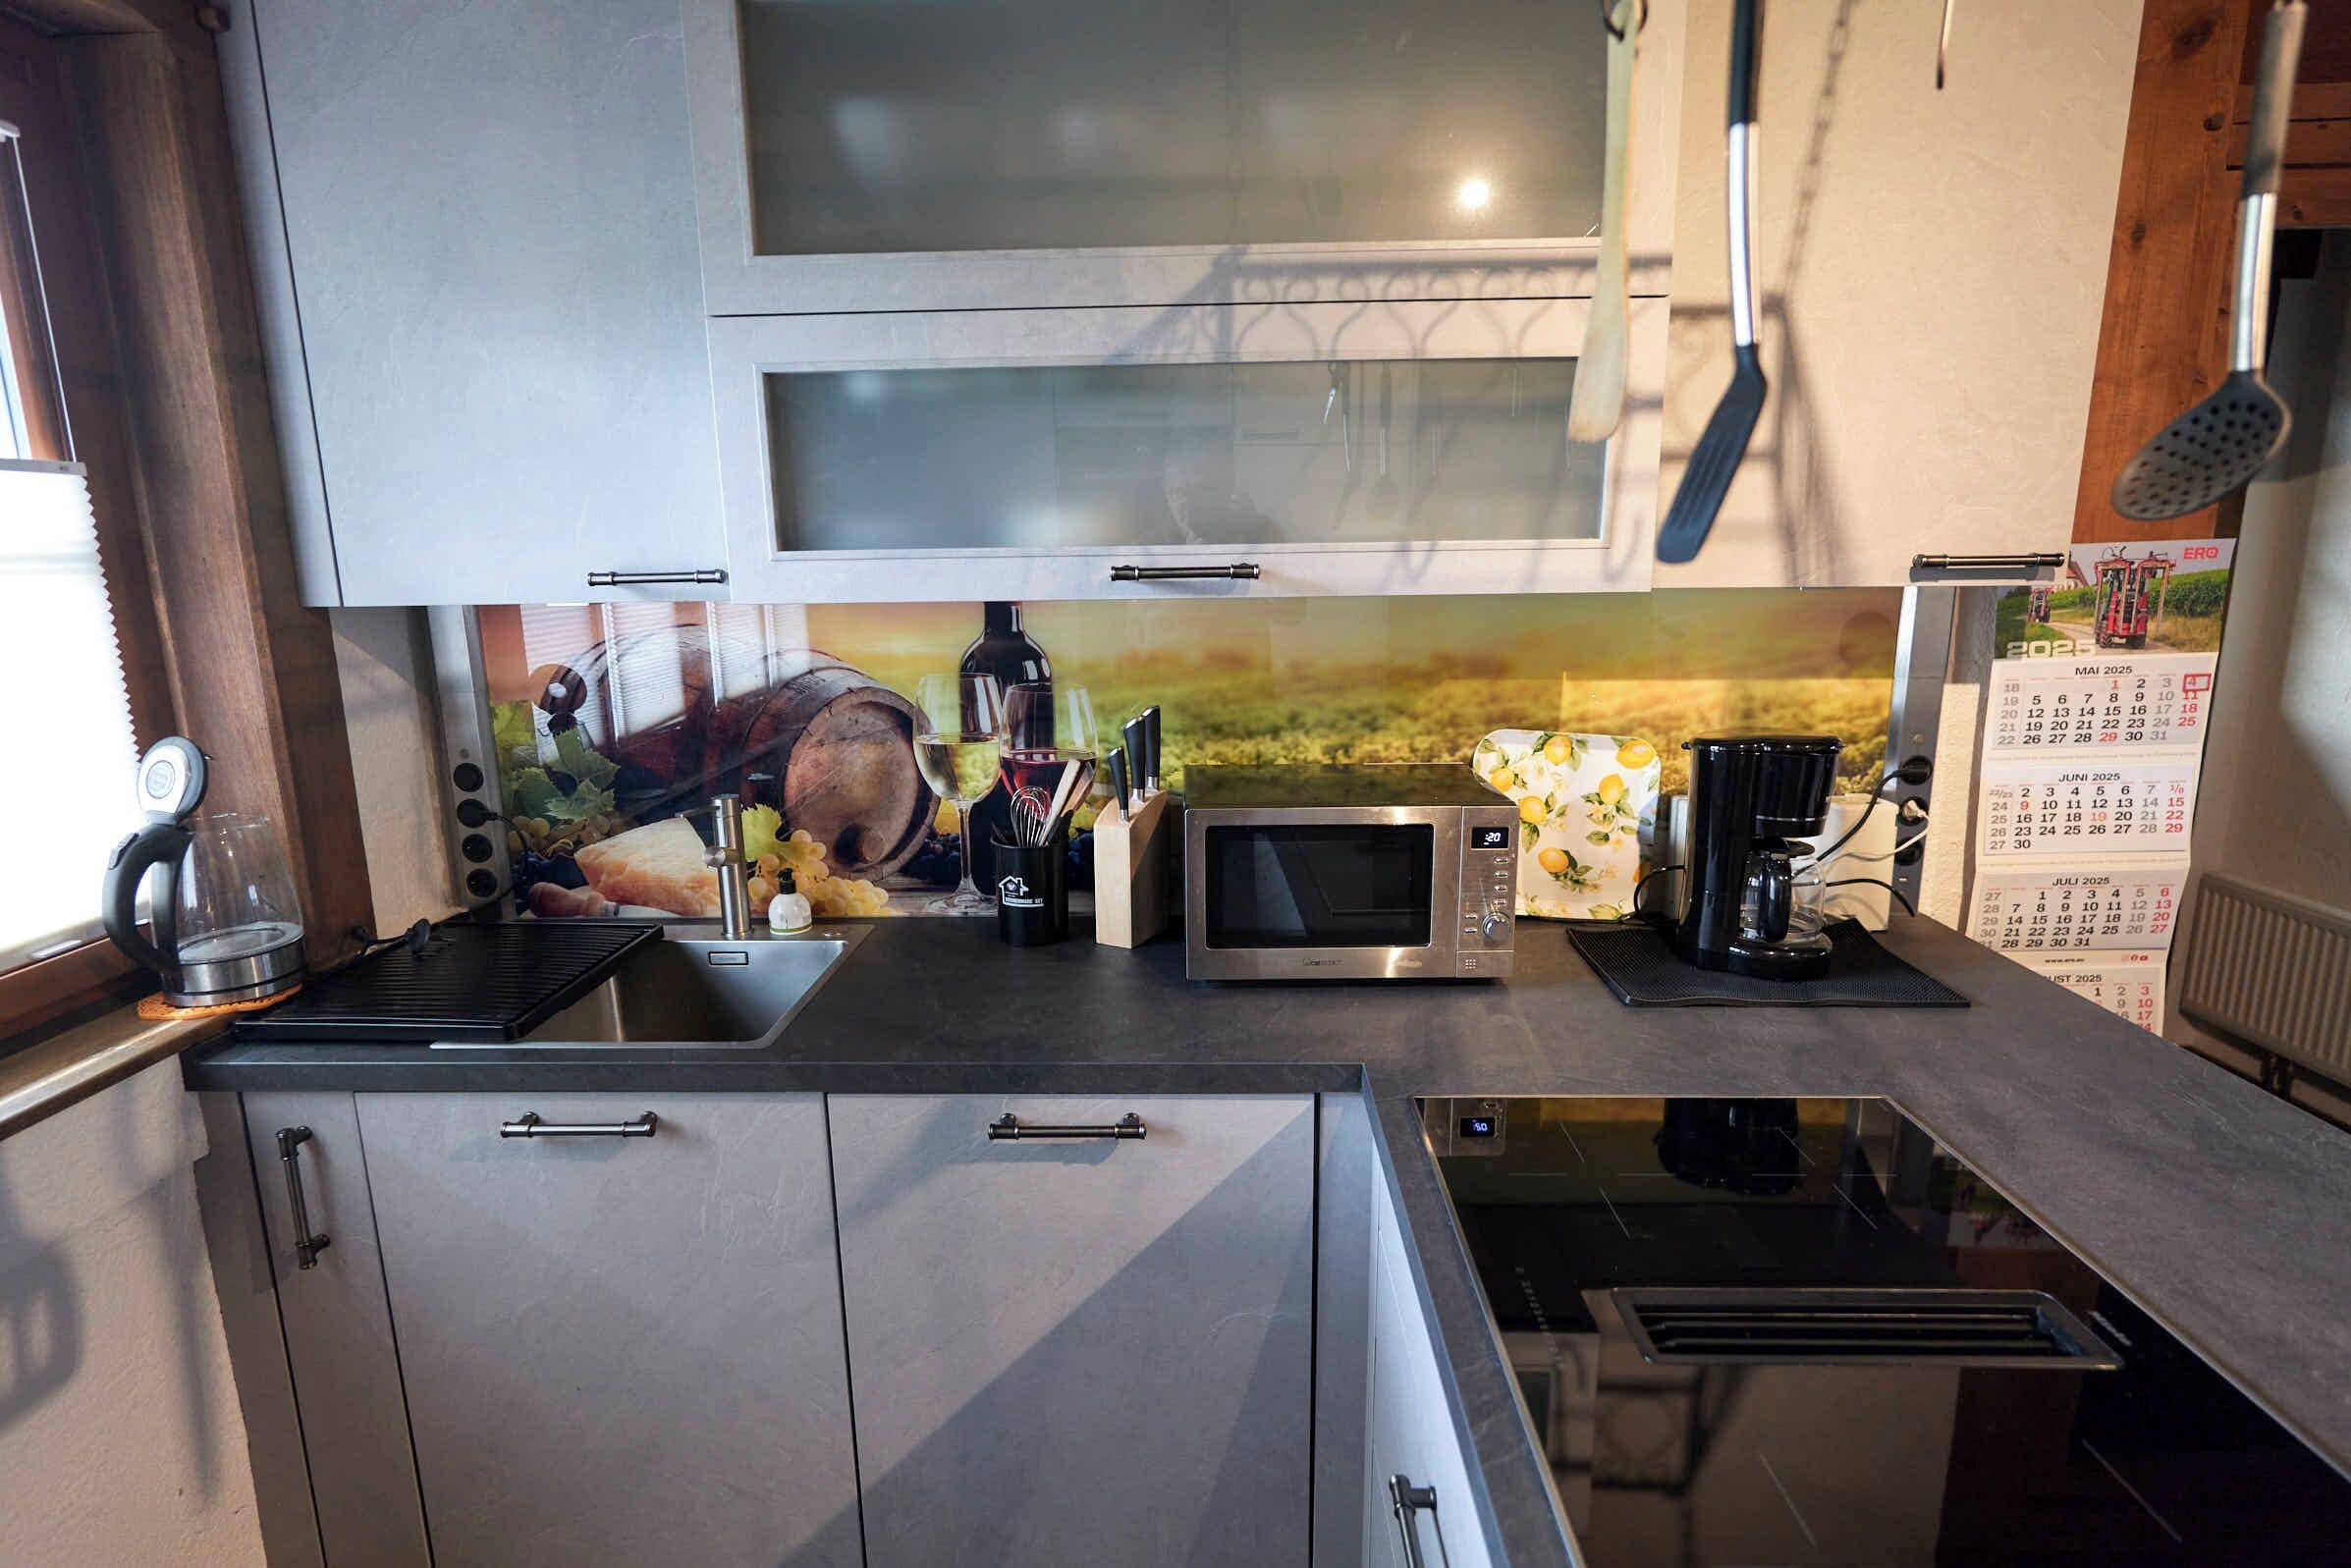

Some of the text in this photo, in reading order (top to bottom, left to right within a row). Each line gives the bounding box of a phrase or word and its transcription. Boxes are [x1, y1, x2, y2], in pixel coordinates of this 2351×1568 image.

[2184, 548, 2218, 560] ERO
[2007, 640, 2097, 659] 2025
[2111, 680, 2117, 689] 1
[2137, 678, 2145, 688] 2
[2162, 678, 2171, 687] 3
[2032, 695, 2041, 705] 5
[2058, 695, 2066, 704] 6
[2084, 694, 2093, 704] 7
[2109, 693, 2118, 703] 8
[2135, 692, 2144, 702] 9
[2159, 692, 2174, 701] 10
[2184, 691, 2198, 700] 11
[2028, 709, 2044, 718] 12
[2053, 708, 2070, 717] 13
[2105, 707, 2120, 716] 15
[2129, 706, 2147, 715] 16
[2155, 705, 2171, 714] 17
[2181, 704, 2198, 713] 18
[2026, 722, 2043, 731] 19
[2050, 722, 2068, 730] 20
[2076, 721, 2093, 730] 21
[2102, 720, 2119, 729] 22
[2178, 718, 2196, 727] 25
[2023, 735, 2041, 744] 26
[2049, 734, 2066, 743] 27
[2074, 733, 2092, 742] 28
[2100, 732, 2117, 741] 29
[2150, 731, 2166, 740] 31
[2059, 773, 2120, 783] JUNI 2025
[2021, 788, 2030, 797] 2
[2097, 786, 2105, 795] 5
[2121, 785, 2130, 794] 6
[2020, 801, 2029, 810] 9
[2066, 800, 2081, 809] 11
[2142, 798, 2159, 807] 14
[2065, 813, 2081, 822] 18
[2091, 813, 2106, 822] 19
[2114, 812, 2132, 821] 20
[2141, 811, 2157, 820] 21
[2165, 811, 2183, 820] 22
[2039, 827, 2056, 836] 24
[2064, 826, 2081, 835] 25
[2113, 825, 2131, 834] 27
[2165, 824, 2182, 833] 29
[2014, 839, 2031, 848] 30
[2037, 903, 2045, 912] 8
[2082, 902, 2098, 911] 10
[2006, 916, 2023, 925] 14
[2056, 915, 2072, 924] 16
[2004, 928, 2020, 937] 21
[2077, 926, 2094, 935] 24
[2095, 987, 2149, 997] 1 2 3
